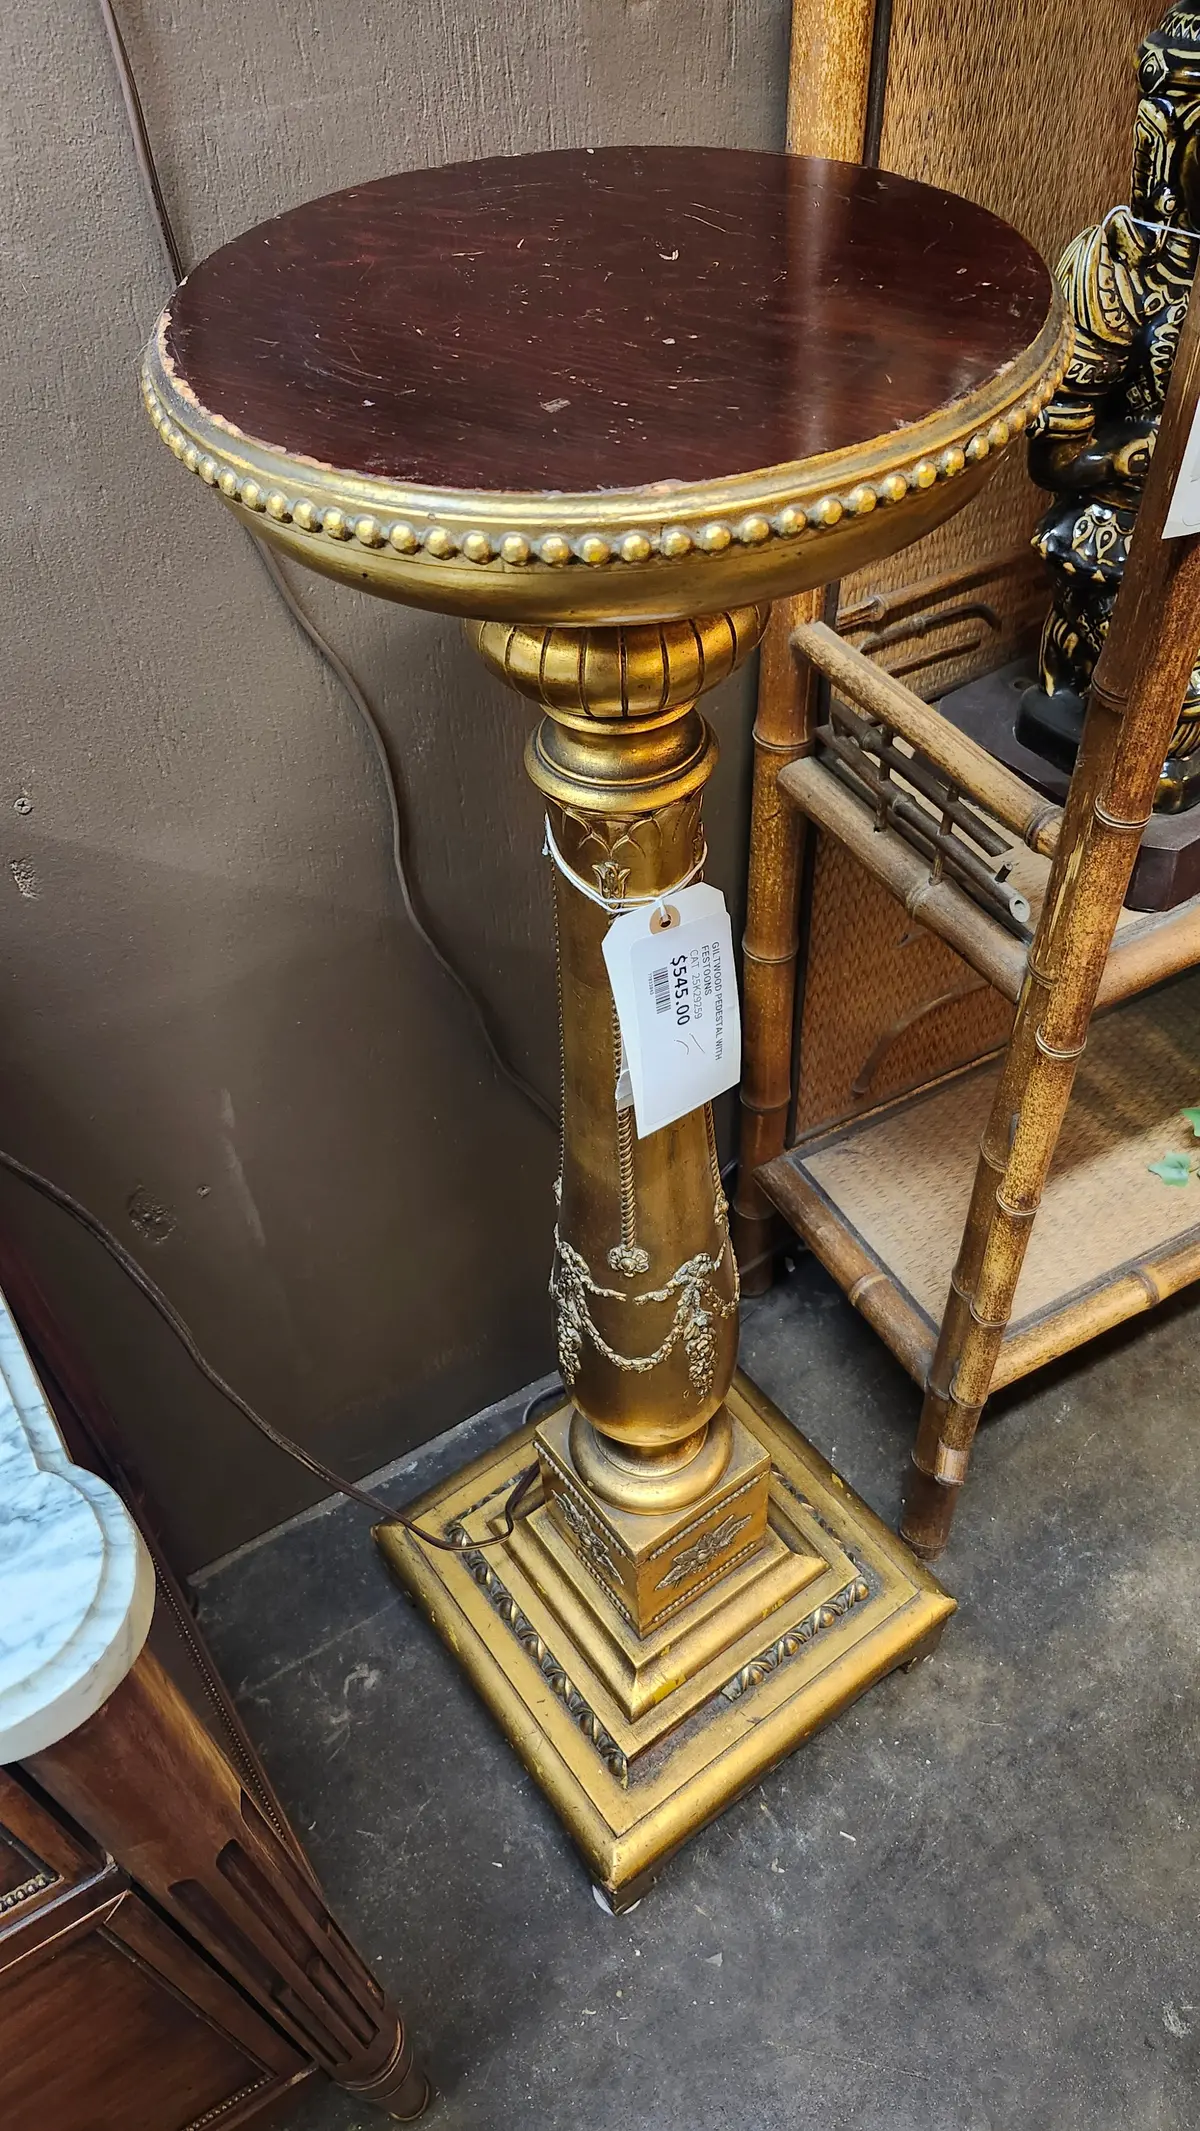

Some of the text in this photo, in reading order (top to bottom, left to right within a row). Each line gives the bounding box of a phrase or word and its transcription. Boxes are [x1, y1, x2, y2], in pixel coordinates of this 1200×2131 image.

[670, 955, 690, 1026] $545.00
[690, 949, 703, 1020] CAT 25K29259
[702, 945, 713, 995] FESTOONS
[712, 942, 723, 1061] GILTWOOD PEDESTAL WITH
